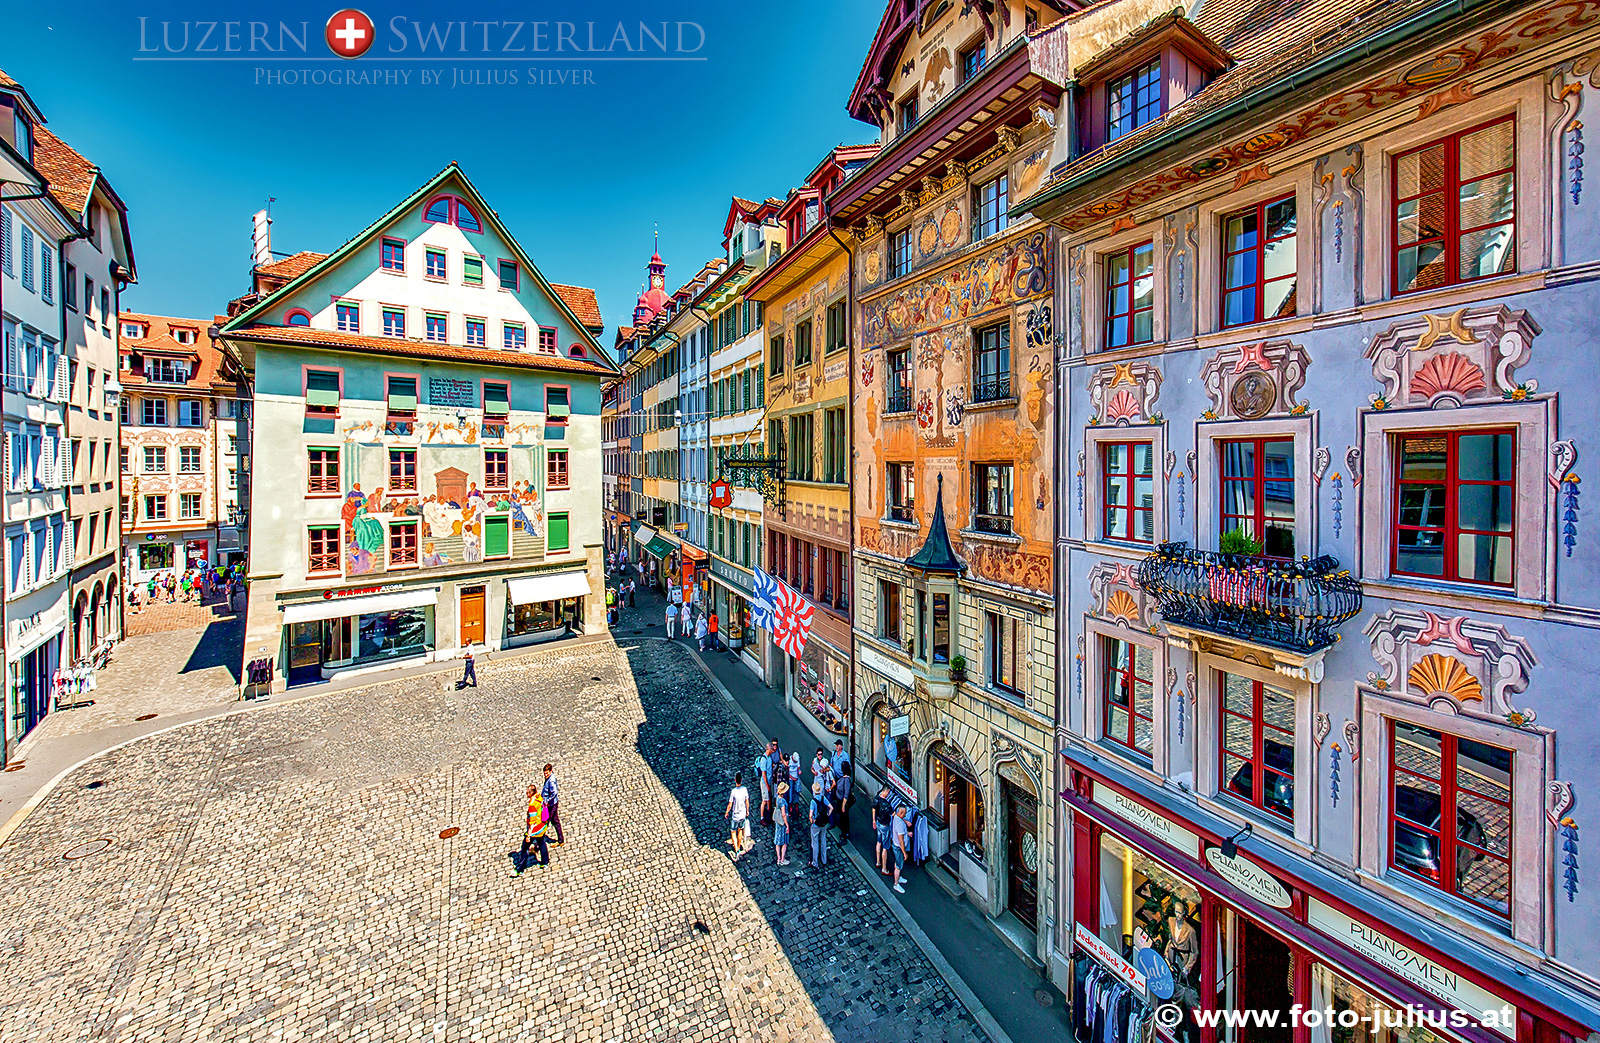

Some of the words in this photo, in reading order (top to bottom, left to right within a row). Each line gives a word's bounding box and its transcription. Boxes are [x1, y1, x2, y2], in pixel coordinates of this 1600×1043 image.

[720, 566, 748, 587] sandro
[1077, 929, 1098, 951] Jedes
[1098, 945, 1119, 970] Stück
[1139, 954, 1169, 980] Sale
[1353, 943, 1378, 964] MODE
[1380, 960, 1400, 974] UND
[1402, 970, 1453, 1004] LIFESTYLE
[1149, 979, 1171, 992] 50%
